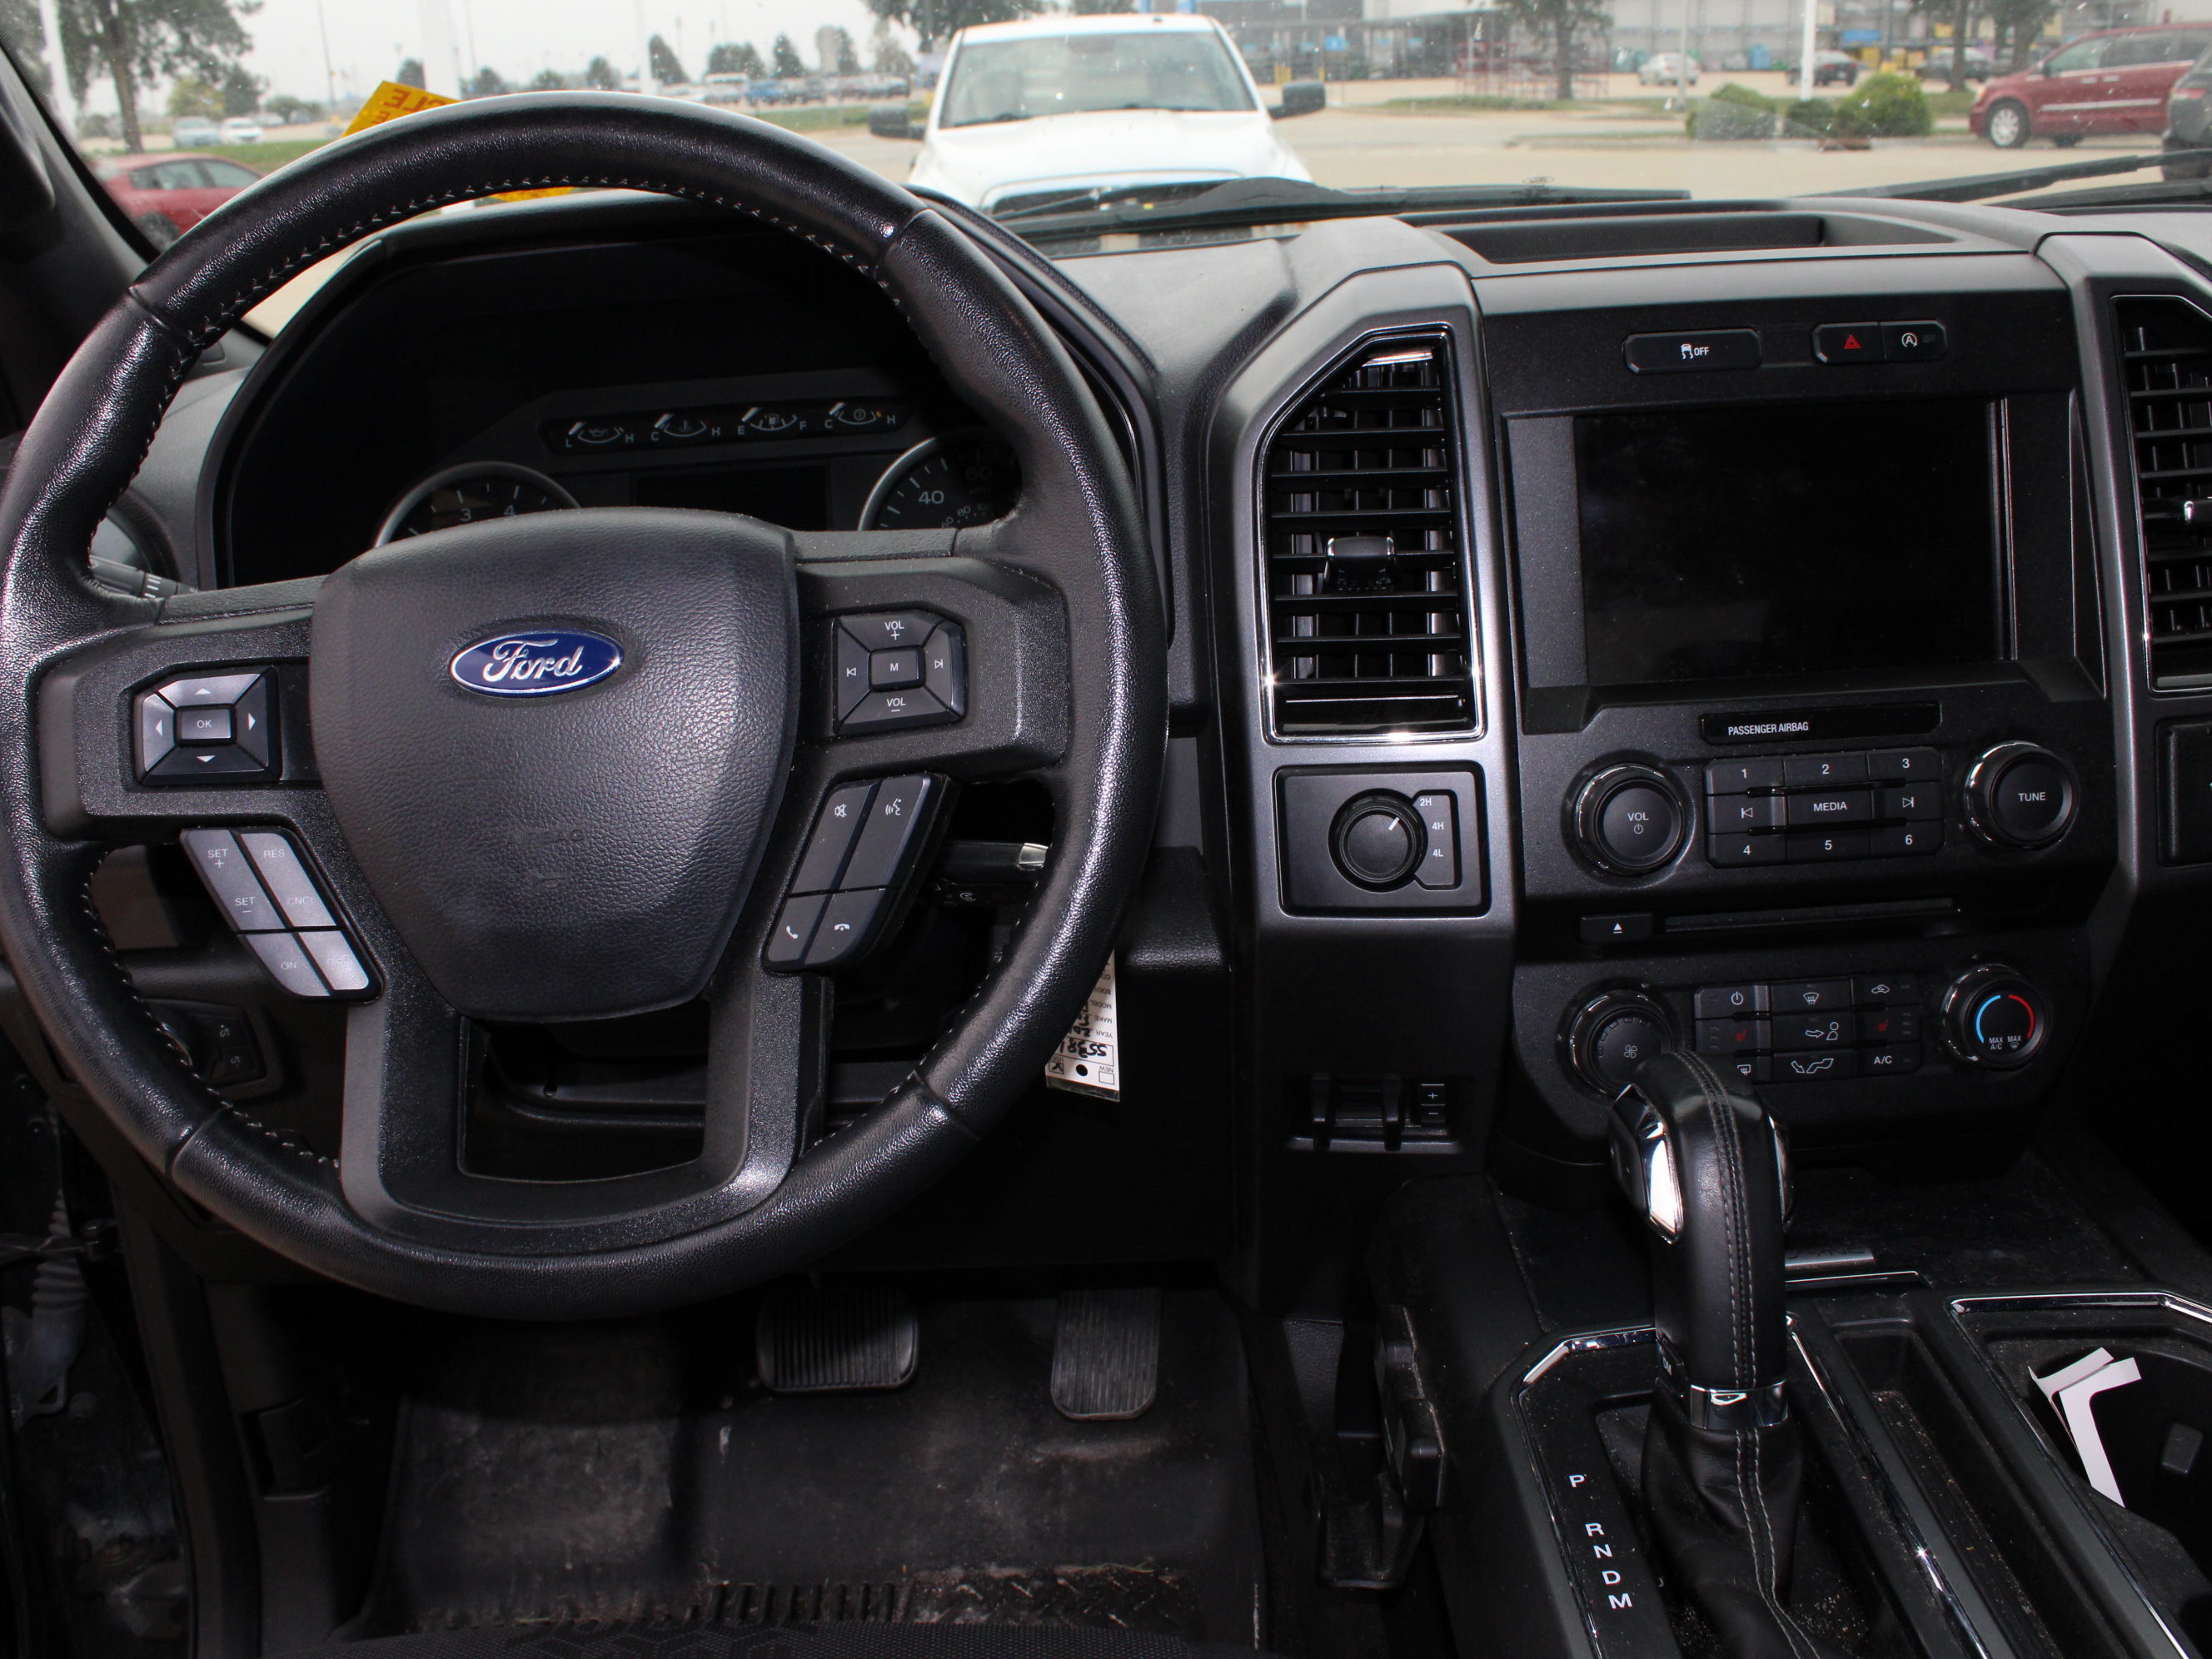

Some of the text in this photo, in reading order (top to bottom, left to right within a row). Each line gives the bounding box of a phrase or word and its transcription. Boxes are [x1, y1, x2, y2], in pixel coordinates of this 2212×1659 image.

[1693, 346, 1710, 356] OFF
[824, 418, 834, 429] C
[886, 414, 896, 425] H
[711, 426, 720, 436] H
[737, 425, 745, 436] E
[799, 421, 807, 431] F
[625, 433, 634, 443] H
[650, 431, 660, 441] C
[565, 438, 573, 448] L
[918, 490, 944, 505] 40
[460, 508, 472, 522] 3
[503, 504, 516, 517] 4
[956, 505, 972, 518] 80
[884, 620, 905, 630] VOL
[481, 639, 585, 681] Ford
[889, 662, 899, 672] M
[886, 697, 907, 707] VOL
[197, 720, 214, 730] OK
[1727, 721, 1809, 736] PASSENGER AIRBAG
[1821, 763, 1830, 775] 2
[1901, 758, 1911, 769] 3
[1741, 768, 1747, 779] 1
[1419, 797, 1432, 807] 2H
[2017, 791, 2046, 802] TUNE
[1813, 801, 1848, 812] MEDIA
[1627, 812, 1649, 822] VOL
[1432, 821, 1444, 830] 4H
[1824, 839, 1833, 850] 5
[1905, 834, 1913, 845] 6
[207, 848, 229, 859] SET
[263, 849, 286, 859] RES
[1432, 848, 1444, 858] 4L
[1742, 844, 1751, 855] 4
[235, 896, 257, 906] SET
[281, 960, 299, 970] ON
[1089, 999, 1113, 1009] MODEL
[1094, 1014, 1113, 1024] MAKE
[1095, 1030, 1113, 1039] YEAR
[1873, 1055, 1892, 1065] A/C
[1099, 1064, 1114, 1073] NEW
[1568, 1474, 1586, 1488] P
[1585, 1522, 1605, 1537] R
[1592, 1543, 1613, 1559] N
[1602, 1570, 1622, 1586] D
[1607, 1592, 1633, 1610] M
